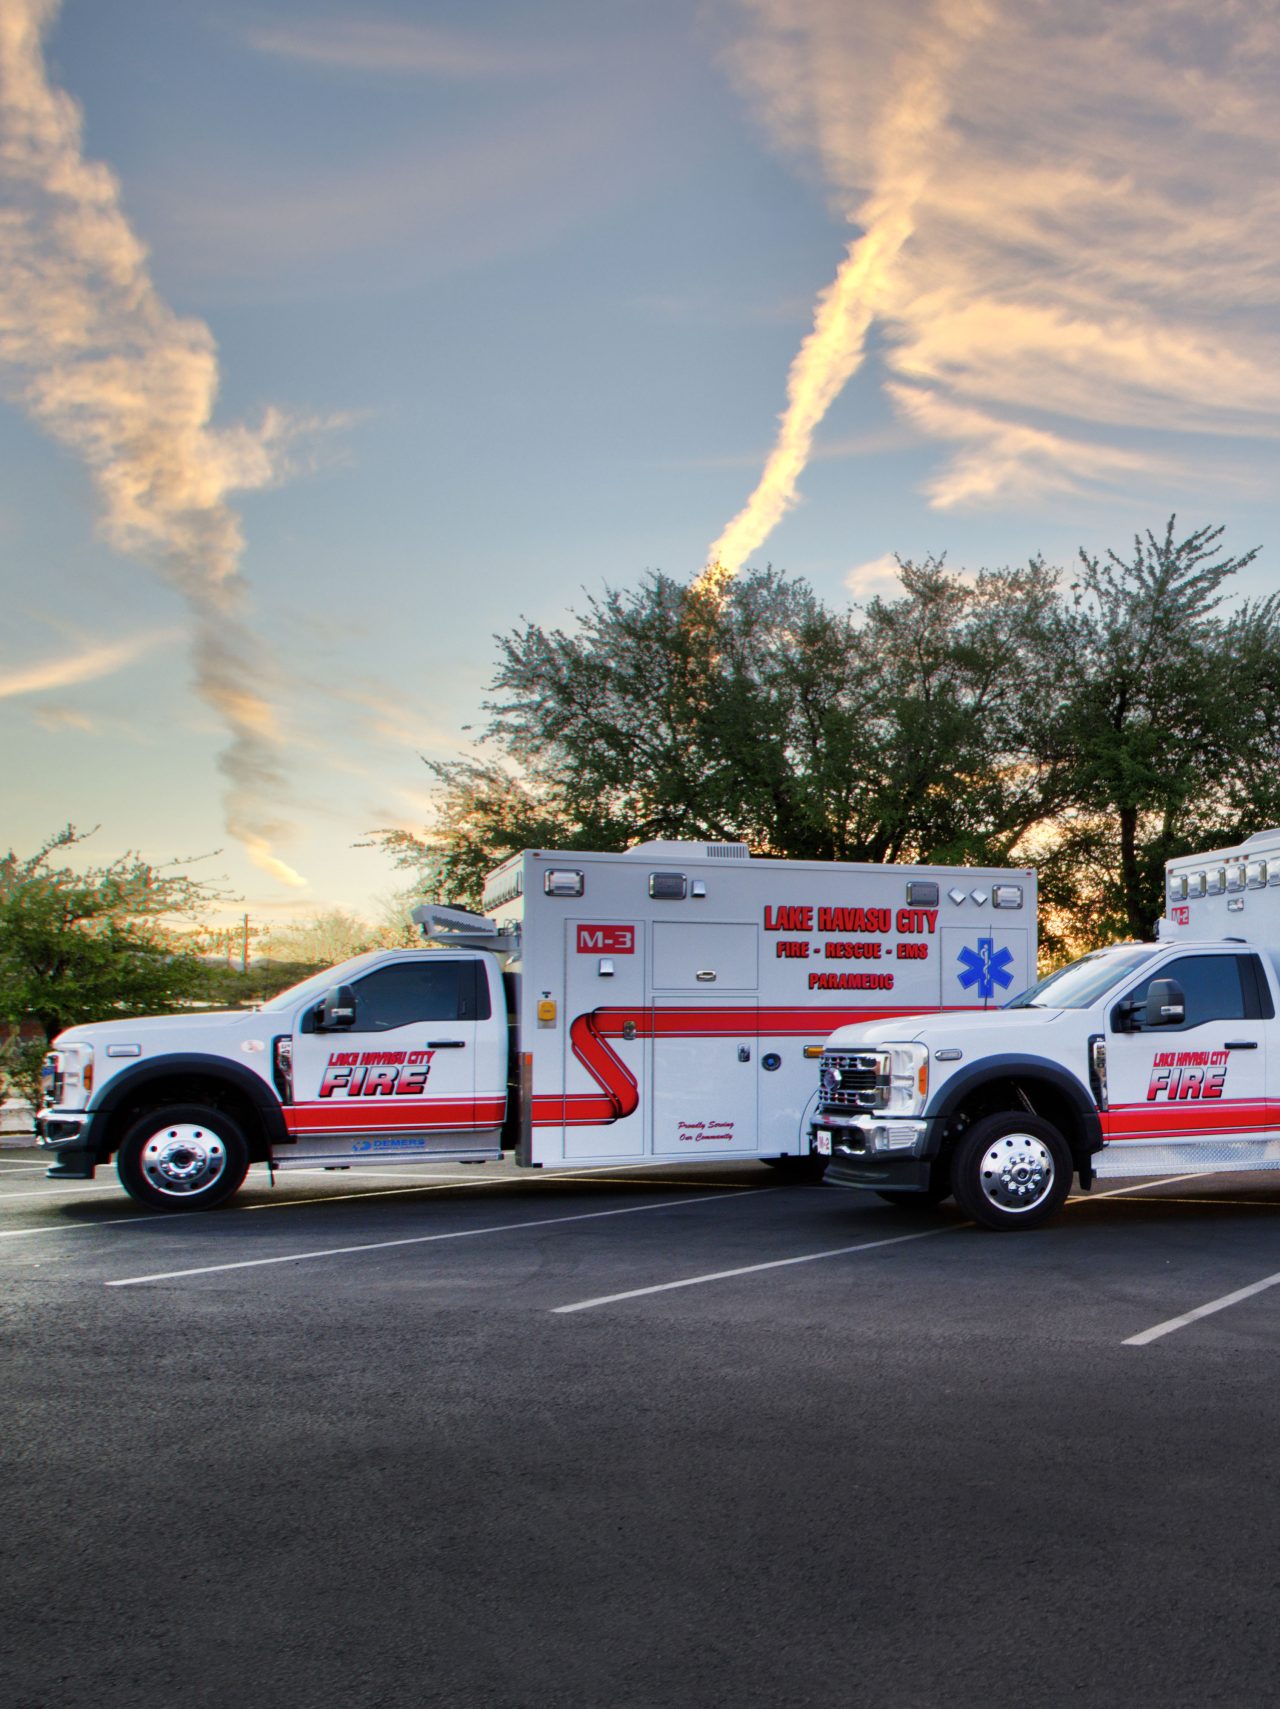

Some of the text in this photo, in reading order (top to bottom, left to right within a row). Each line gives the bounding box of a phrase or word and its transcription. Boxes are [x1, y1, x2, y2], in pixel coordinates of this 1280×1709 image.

[764, 905, 939, 934] LAKE HAVASU CITY
[580, 931, 632, 948] M-3
[777, 941, 809, 958] FIRE
[825, 942, 882, 959] RESCUE
[897, 943, 928, 960] EMS
[809, 973, 894, 990] PARAMEDIC
[328, 1050, 436, 1066] LAKE HAVASU CITY
[1153, 1051, 1231, 1067] LAKE HAVASU CITY
[318, 1065, 431, 1098] FIRE
[1147, 1067, 1227, 1101] FIRE
[678, 1120, 734, 1130] Proudly Serving
[679, 1132, 733, 1141] Our Community
